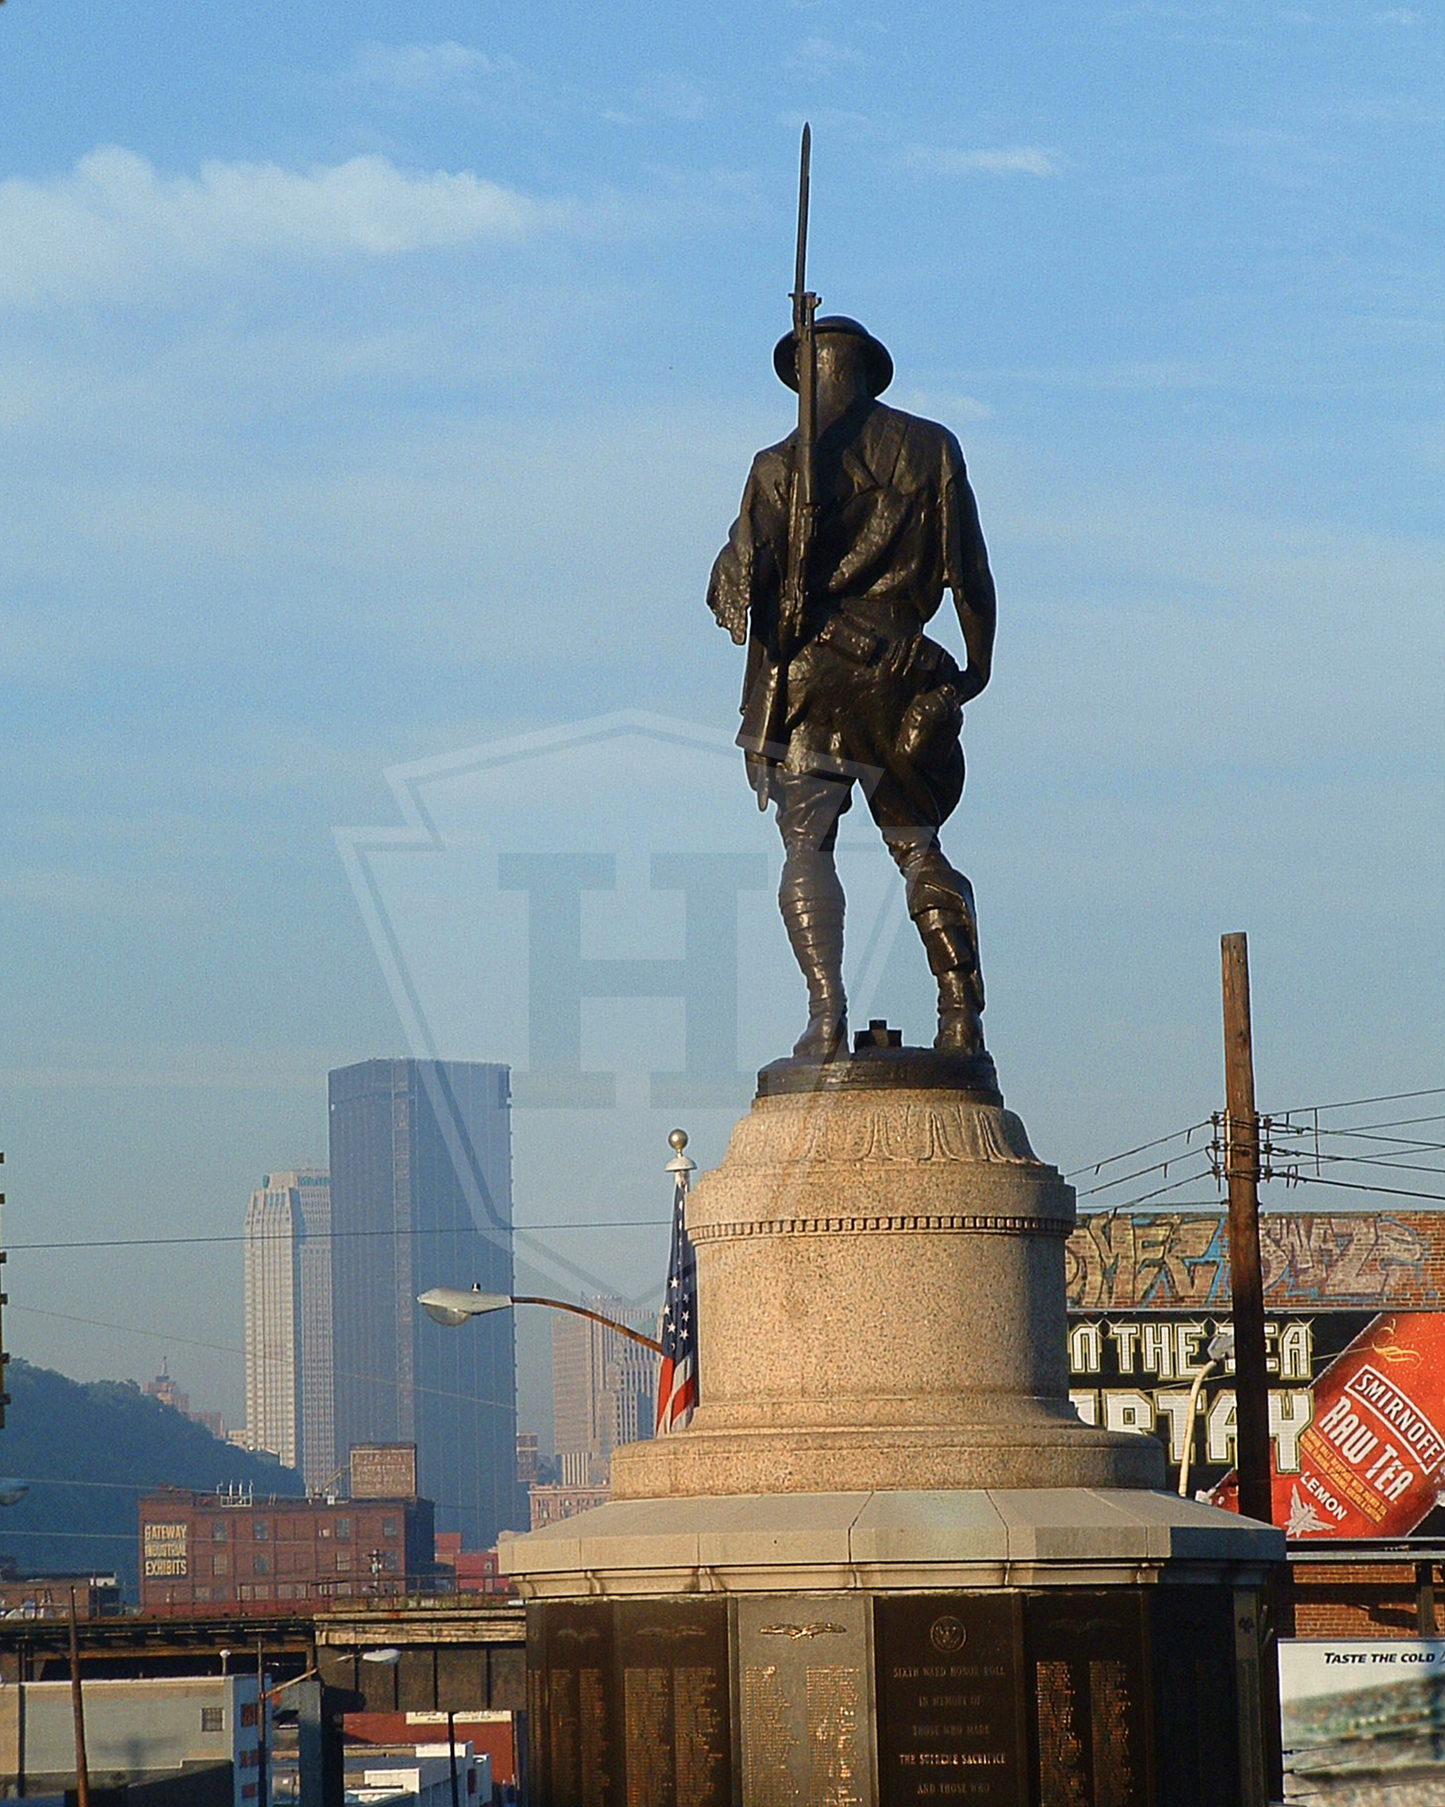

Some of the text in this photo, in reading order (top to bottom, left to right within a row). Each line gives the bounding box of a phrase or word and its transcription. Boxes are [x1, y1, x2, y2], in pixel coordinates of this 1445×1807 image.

[1110, 1323, 1206, 1381] THE
[1354, 1373, 1441, 1460] SMIRNOFF
[1318, 1396, 1414, 1501] RAW TEA
[1300, 1471, 1348, 1521] LEMON
[145, 1525, 187, 1540] GATEWAY
[146, 1560, 187, 1576] EXHIBITS
[1324, 1652, 1436, 1664] TASTE THE COLD
[899, 1754, 916, 1765] THE
[962, 1753, 1006, 1765] SACRIFICE
[917, 1783, 936, 1794] AND
